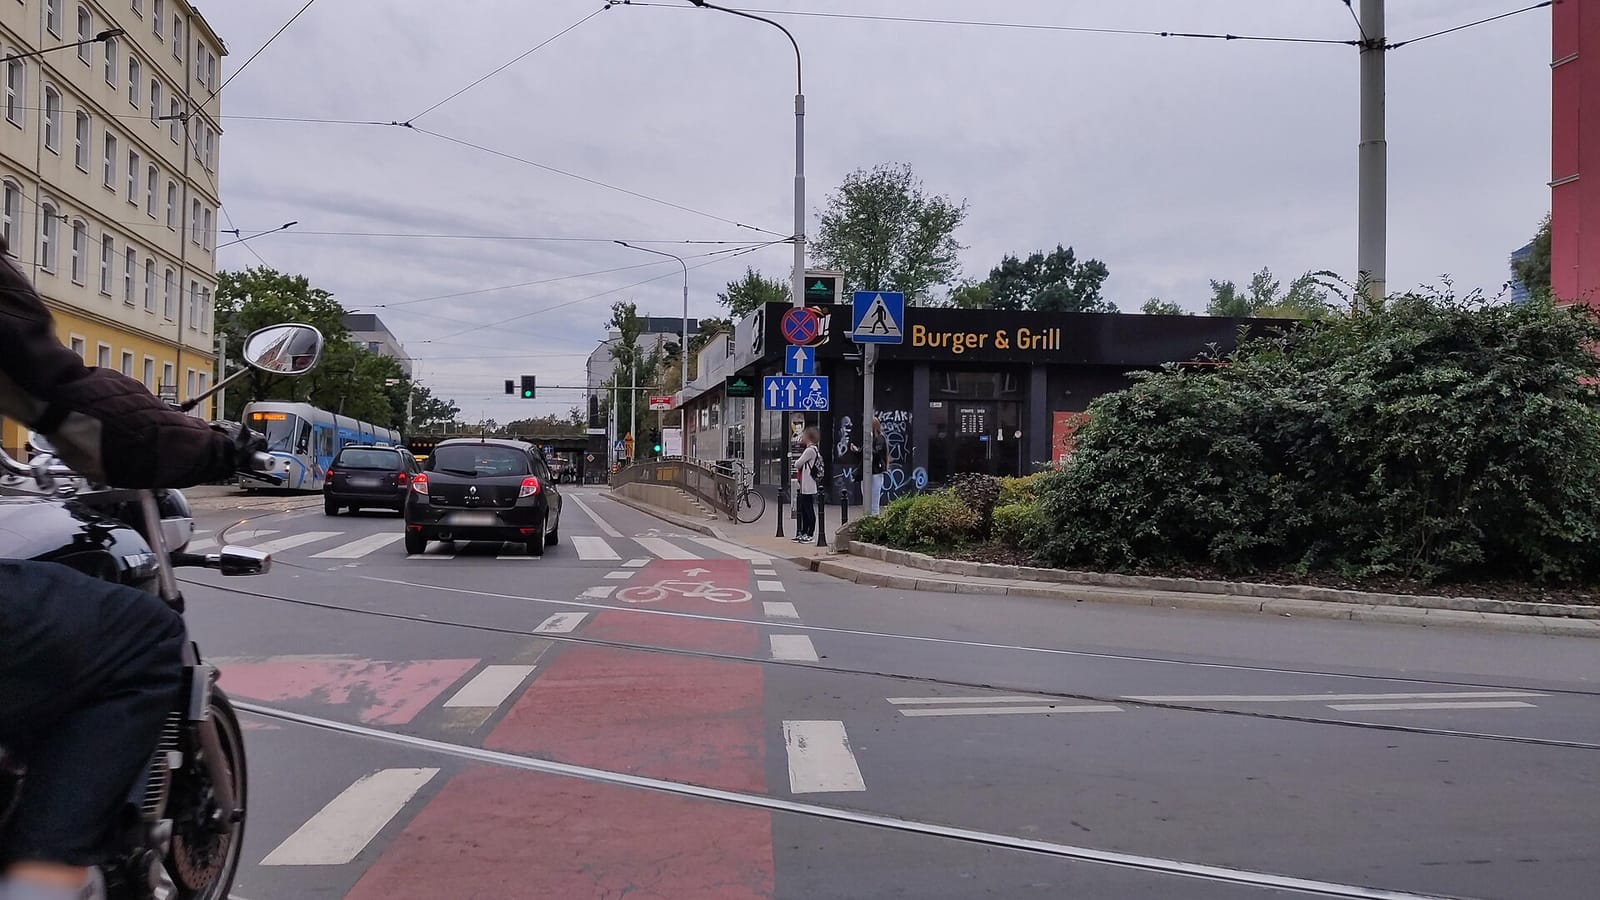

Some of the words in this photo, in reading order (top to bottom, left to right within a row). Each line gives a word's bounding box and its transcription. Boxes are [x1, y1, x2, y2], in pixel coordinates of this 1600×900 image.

[912, 324, 988, 354] Burger
[994, 329, 1010, 349] &
[1016, 327, 1061, 350] Grill
